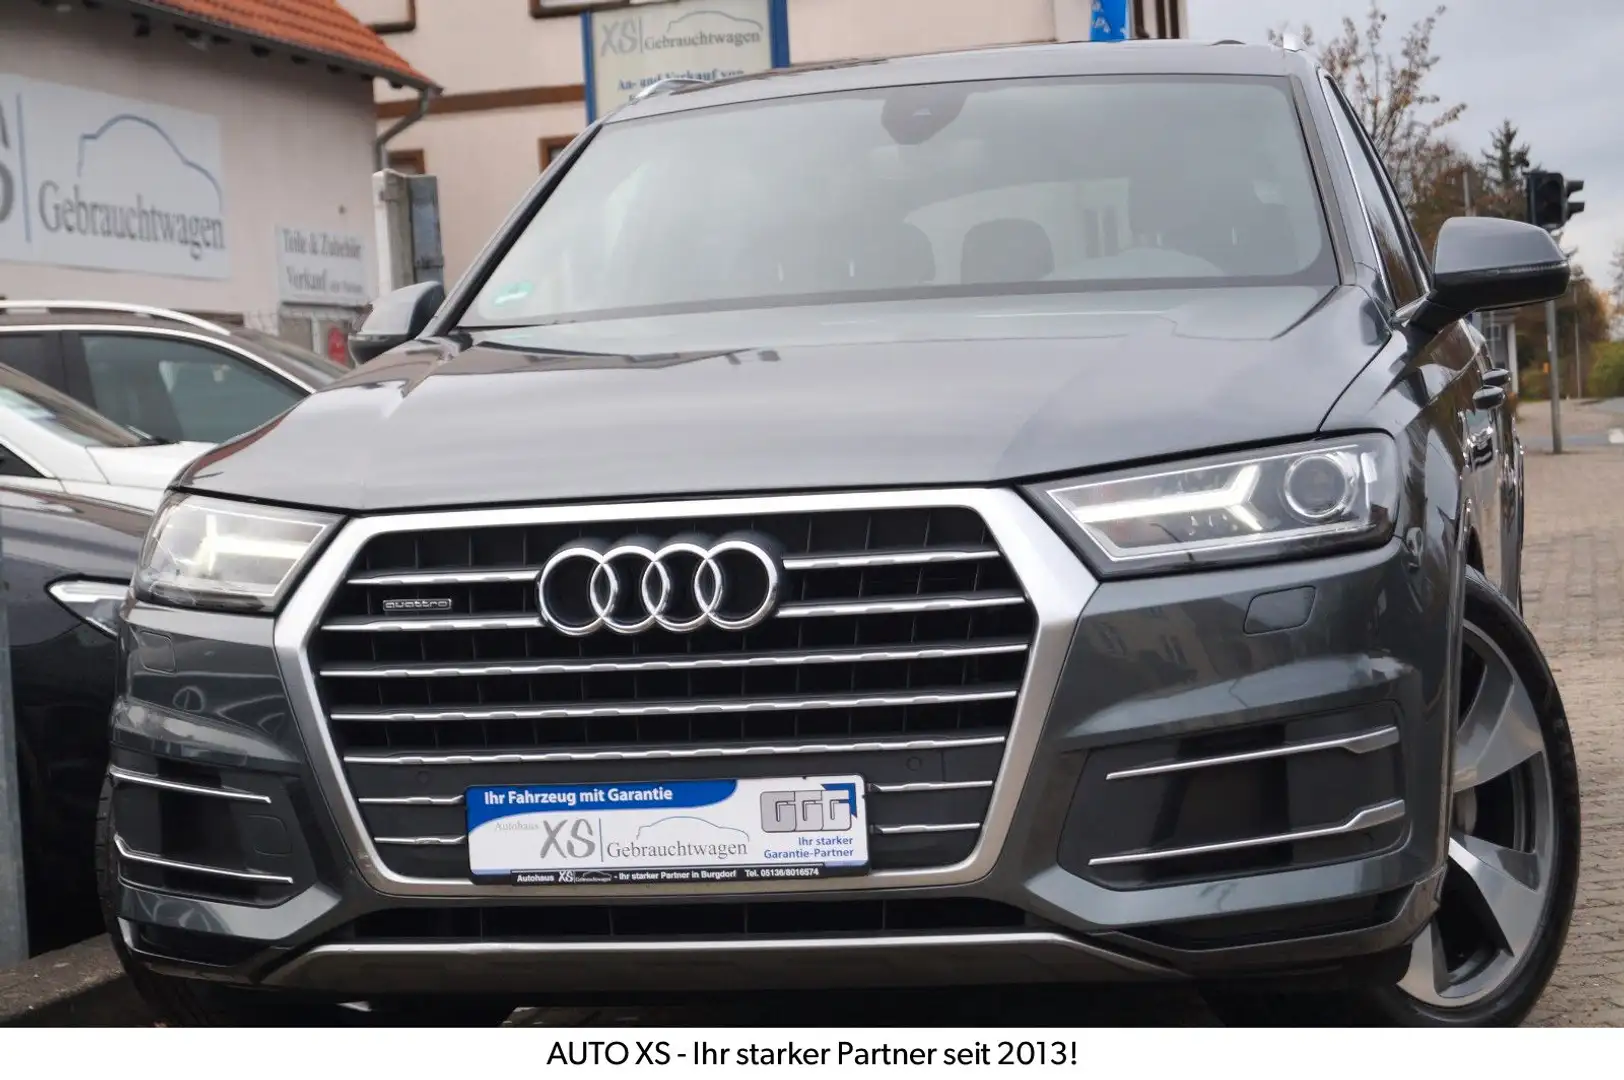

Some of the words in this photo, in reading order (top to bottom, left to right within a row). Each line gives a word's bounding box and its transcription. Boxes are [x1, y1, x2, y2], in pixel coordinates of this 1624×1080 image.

[601, 17, 638, 57] XS
[644, 31, 761, 50] Gebrauchtwagen
[38, 179, 225, 261] Gebrauchtwagen
[385, 600, 448, 609] quattro
[485, 791, 505, 804] Ihr
[508, 790, 576, 806] Fahrzeug
[580, 789, 604, 802] mit
[608, 787, 673, 801] Garantie
[494, 822, 540, 832] Autohaus
[540, 818, 596, 859] XS
[607, 840, 748, 860] Gebrauchtwagen
[798, 837, 813, 846] Ihr
[816, 836, 853, 846] starker
[764, 848, 854, 859] Garantie-Partner
[517, 874, 554, 883] Autohaus
[558, 870, 574, 883] XS
[619, 871, 629, 880] Ihr
[632, 872, 659, 880] starker
[661, 870, 690, 880] Partner
[692, 870, 700, 879] in
[701, 869, 737, 880] Burgdorf
[745, 868, 759, 877] Tel.
[760, 867, 819, 877] 05136/8016574
